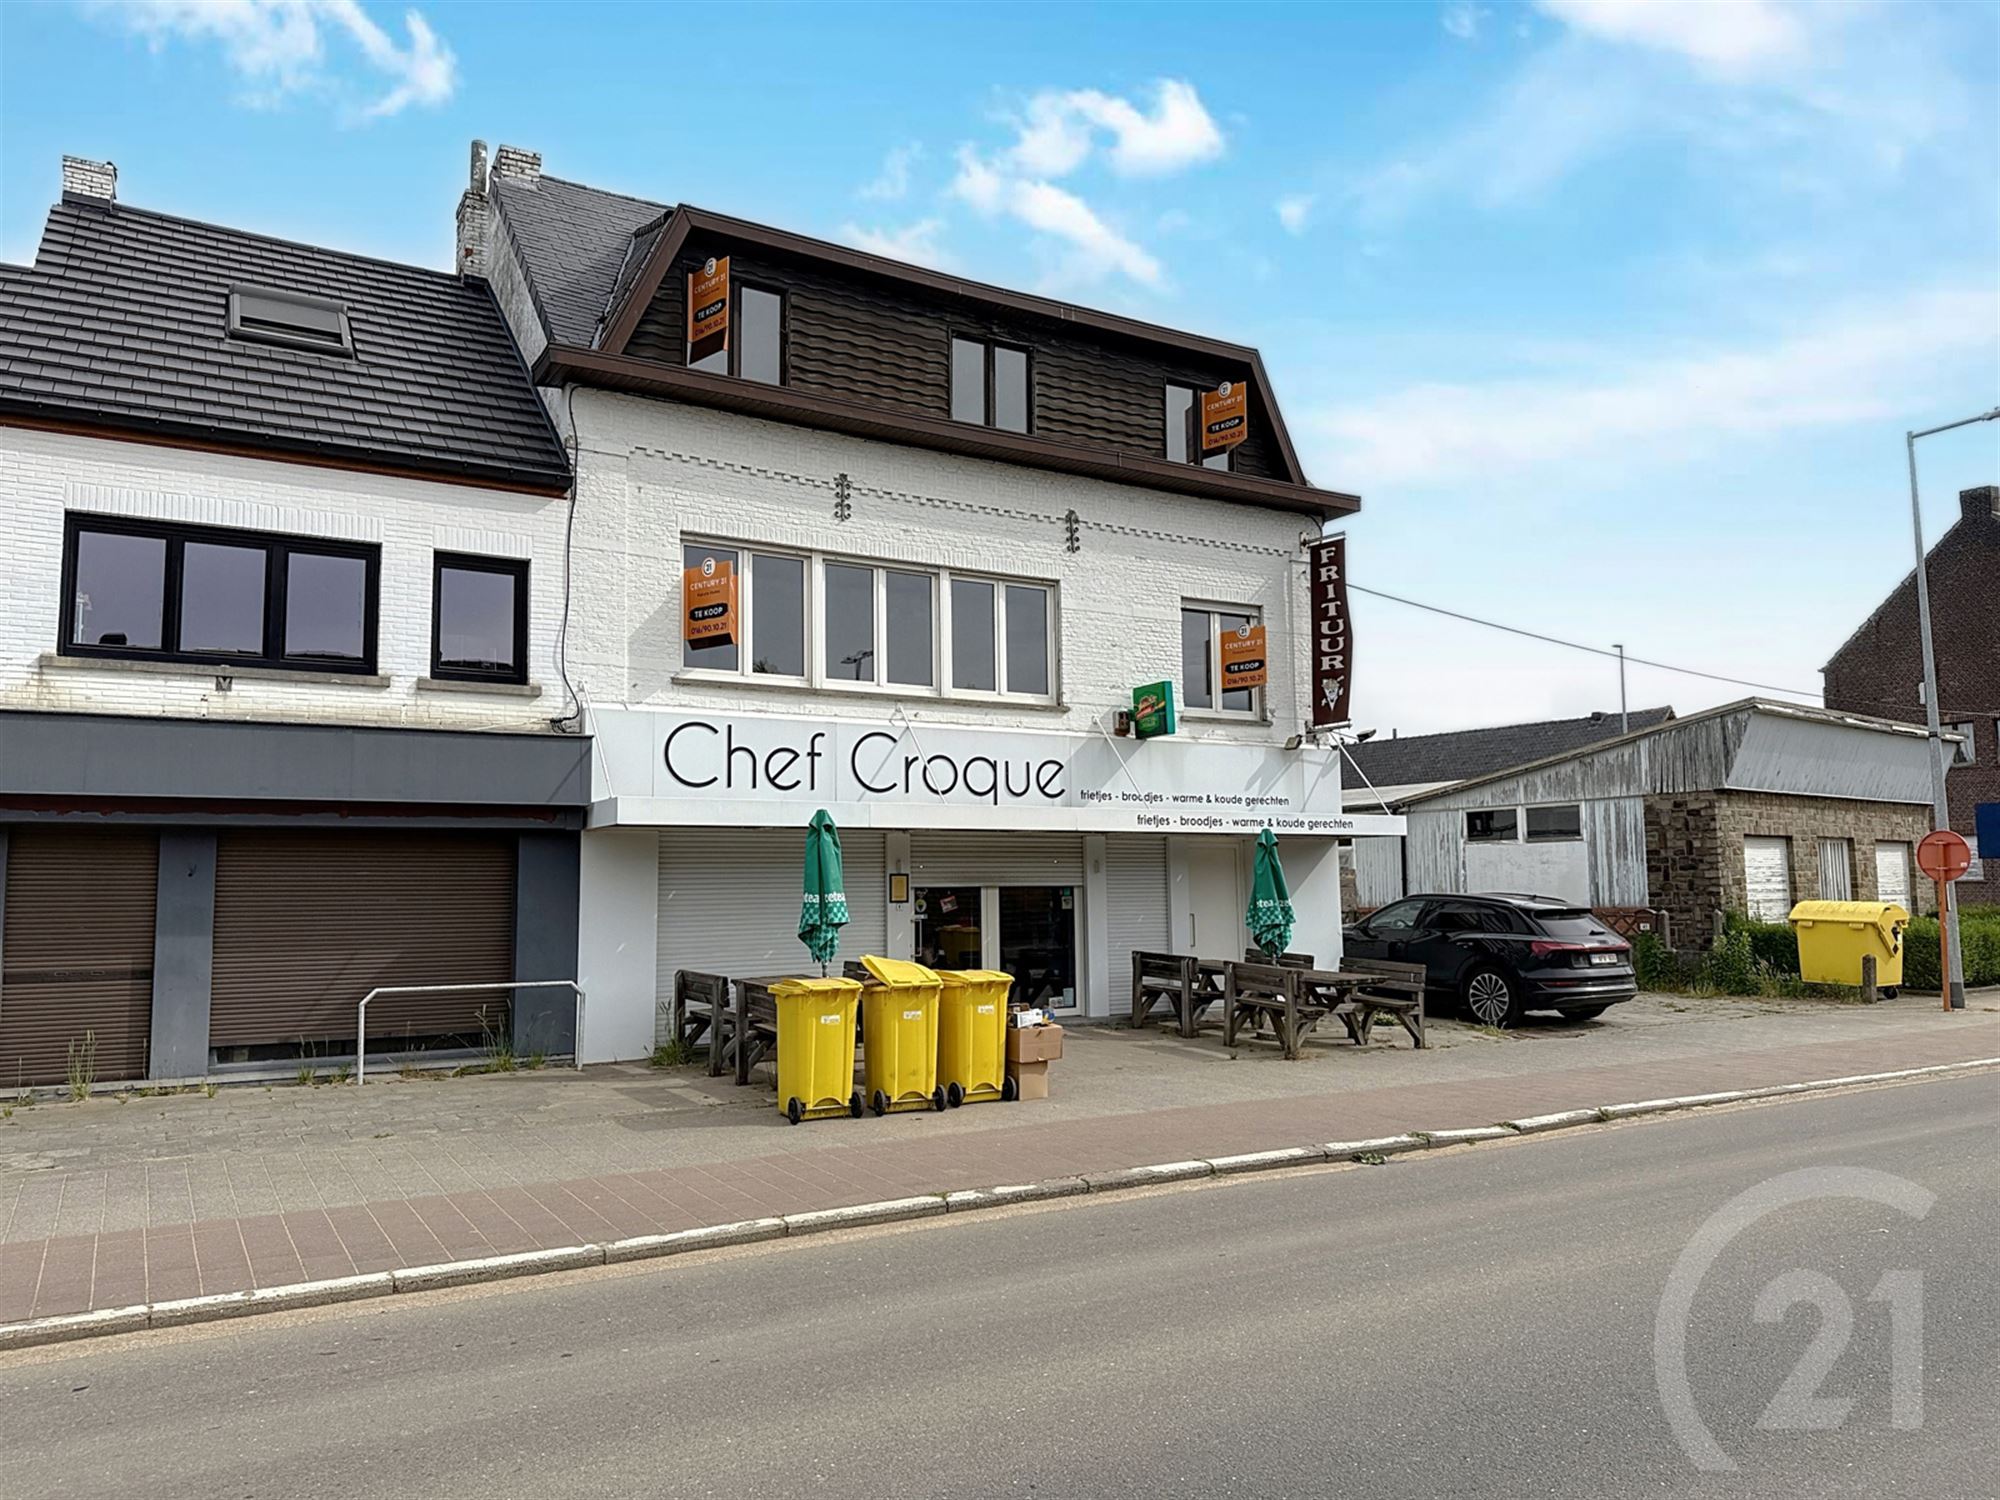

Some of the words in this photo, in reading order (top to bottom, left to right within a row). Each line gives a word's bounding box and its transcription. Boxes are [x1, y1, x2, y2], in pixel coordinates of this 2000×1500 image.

[694, 275, 719, 294] CENTURY
[697, 311, 705, 322] TE
[705, 302, 722, 317] KOOP
[1207, 398, 1235, 411] CENTURY
[1221, 418, 1240, 429] KOOP
[690, 579, 720, 591] CENTURY
[694, 610, 702, 618] TE
[704, 607, 723, 617] KOOP
[1318, 547, 1345, 671] FRITUUR
[1224, 640, 1255, 650] CENTURY
[1240, 662, 1260, 670] KOOP
[664, 721, 826, 791] Chef
[851, 731, 1066, 806] Croque
[1080, 789, 1112, 803] frietjes
[1172, 794, 1204, 803] warme
[1205, 794, 1212, 803] &
[1214, 794, 1243, 805] koude
[1245, 795, 1290, 807] gerechten
[1137, 814, 1170, 828] frietjes
[1180, 815, 1223, 829] broodjes
[1232, 818, 1265, 827] warme
[1267, 818, 1274, 827] &
[1276, 817, 1305, 828] koude
[1307, 818, 1354, 830] gerechten
